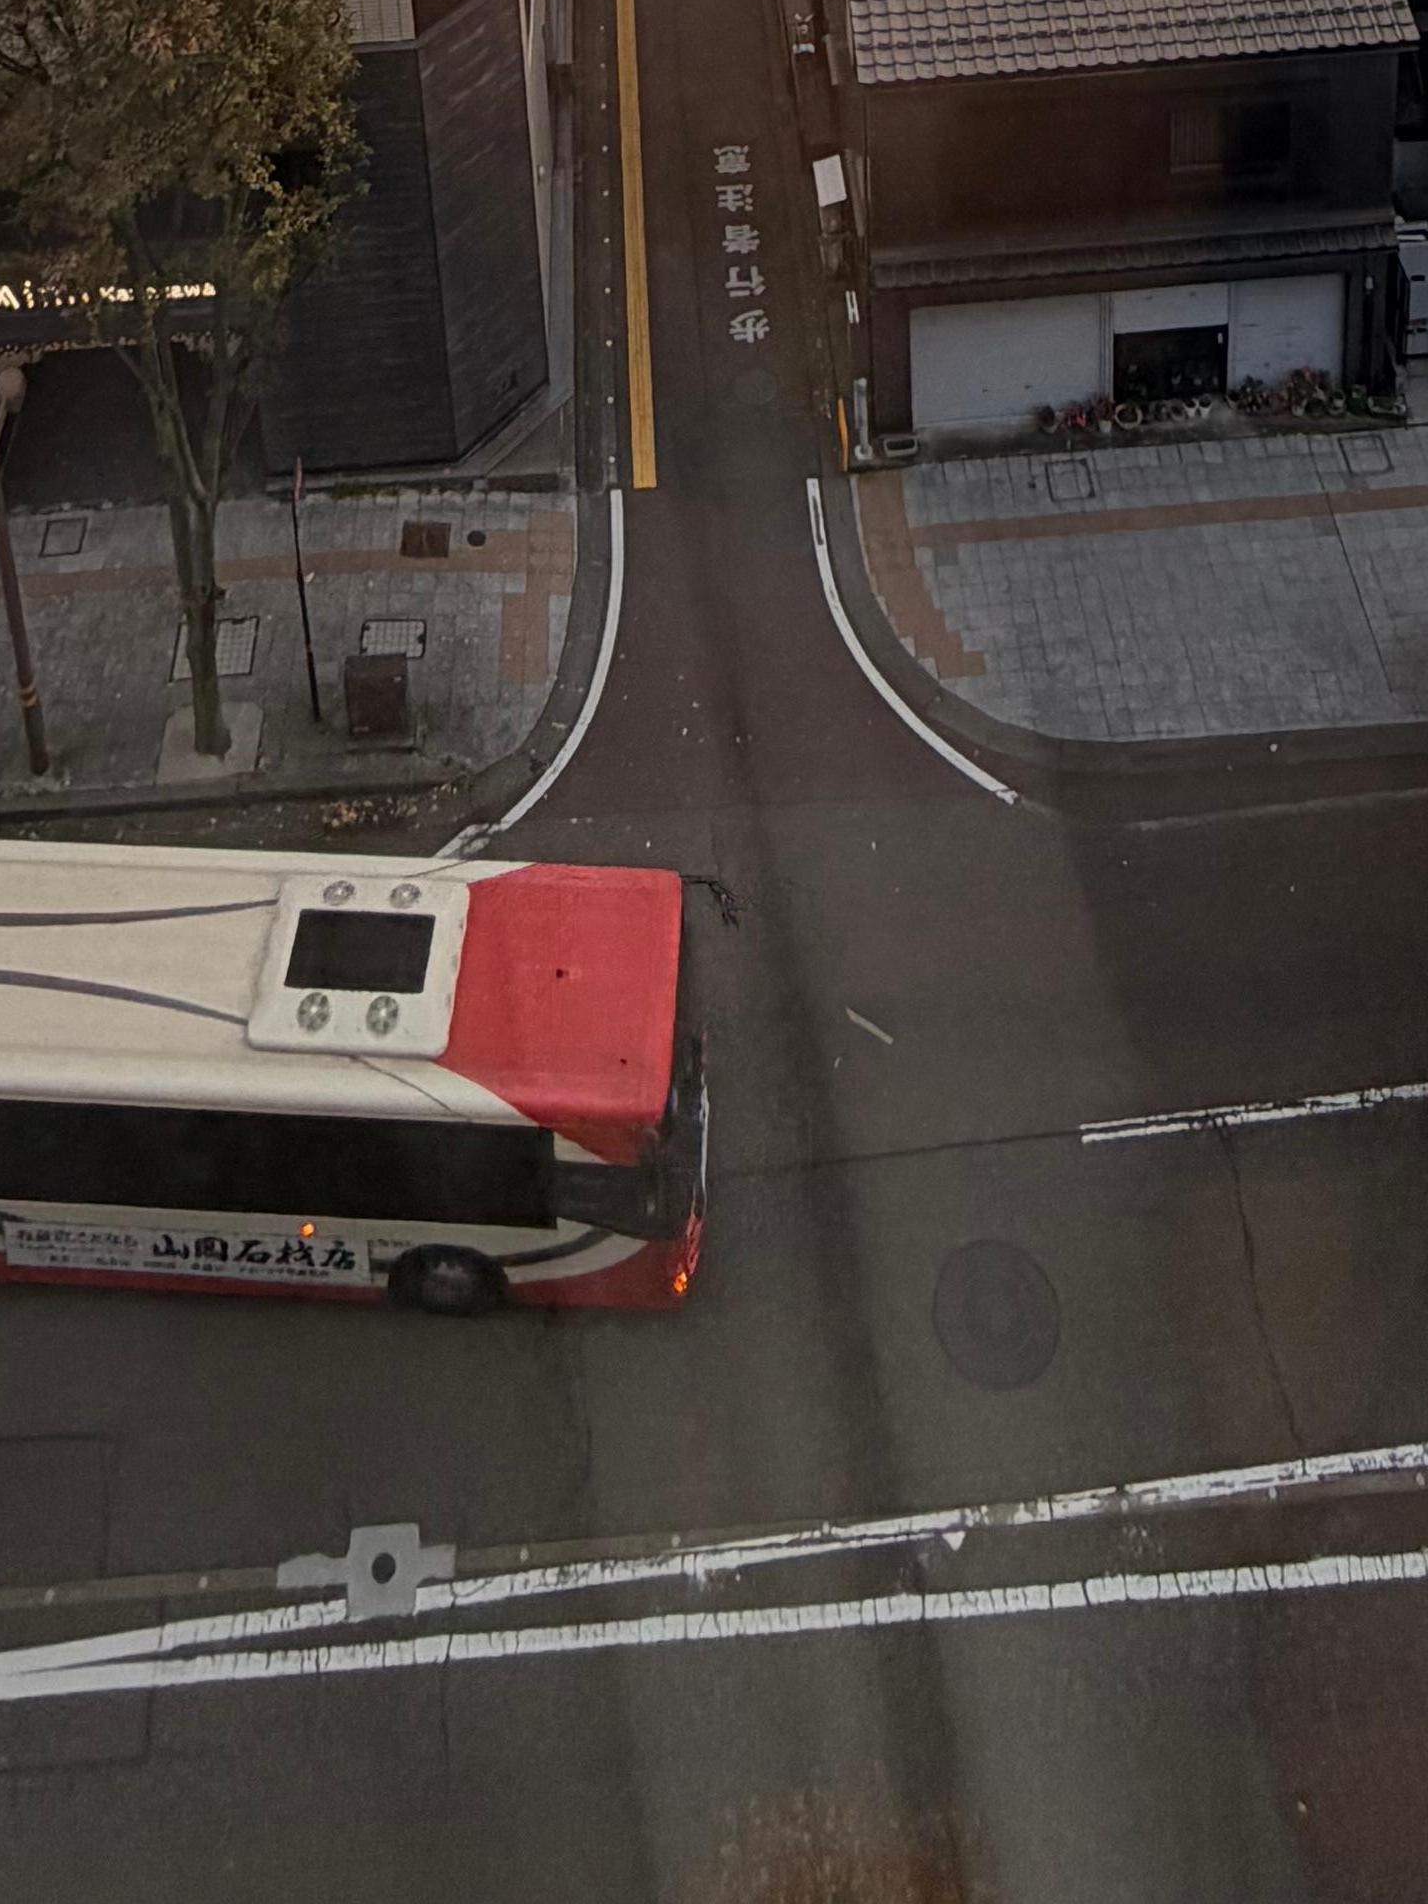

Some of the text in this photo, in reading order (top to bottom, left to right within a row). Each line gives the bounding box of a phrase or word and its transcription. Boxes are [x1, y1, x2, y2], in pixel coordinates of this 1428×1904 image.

[713, 145, 770, 343] 歩行者注意
